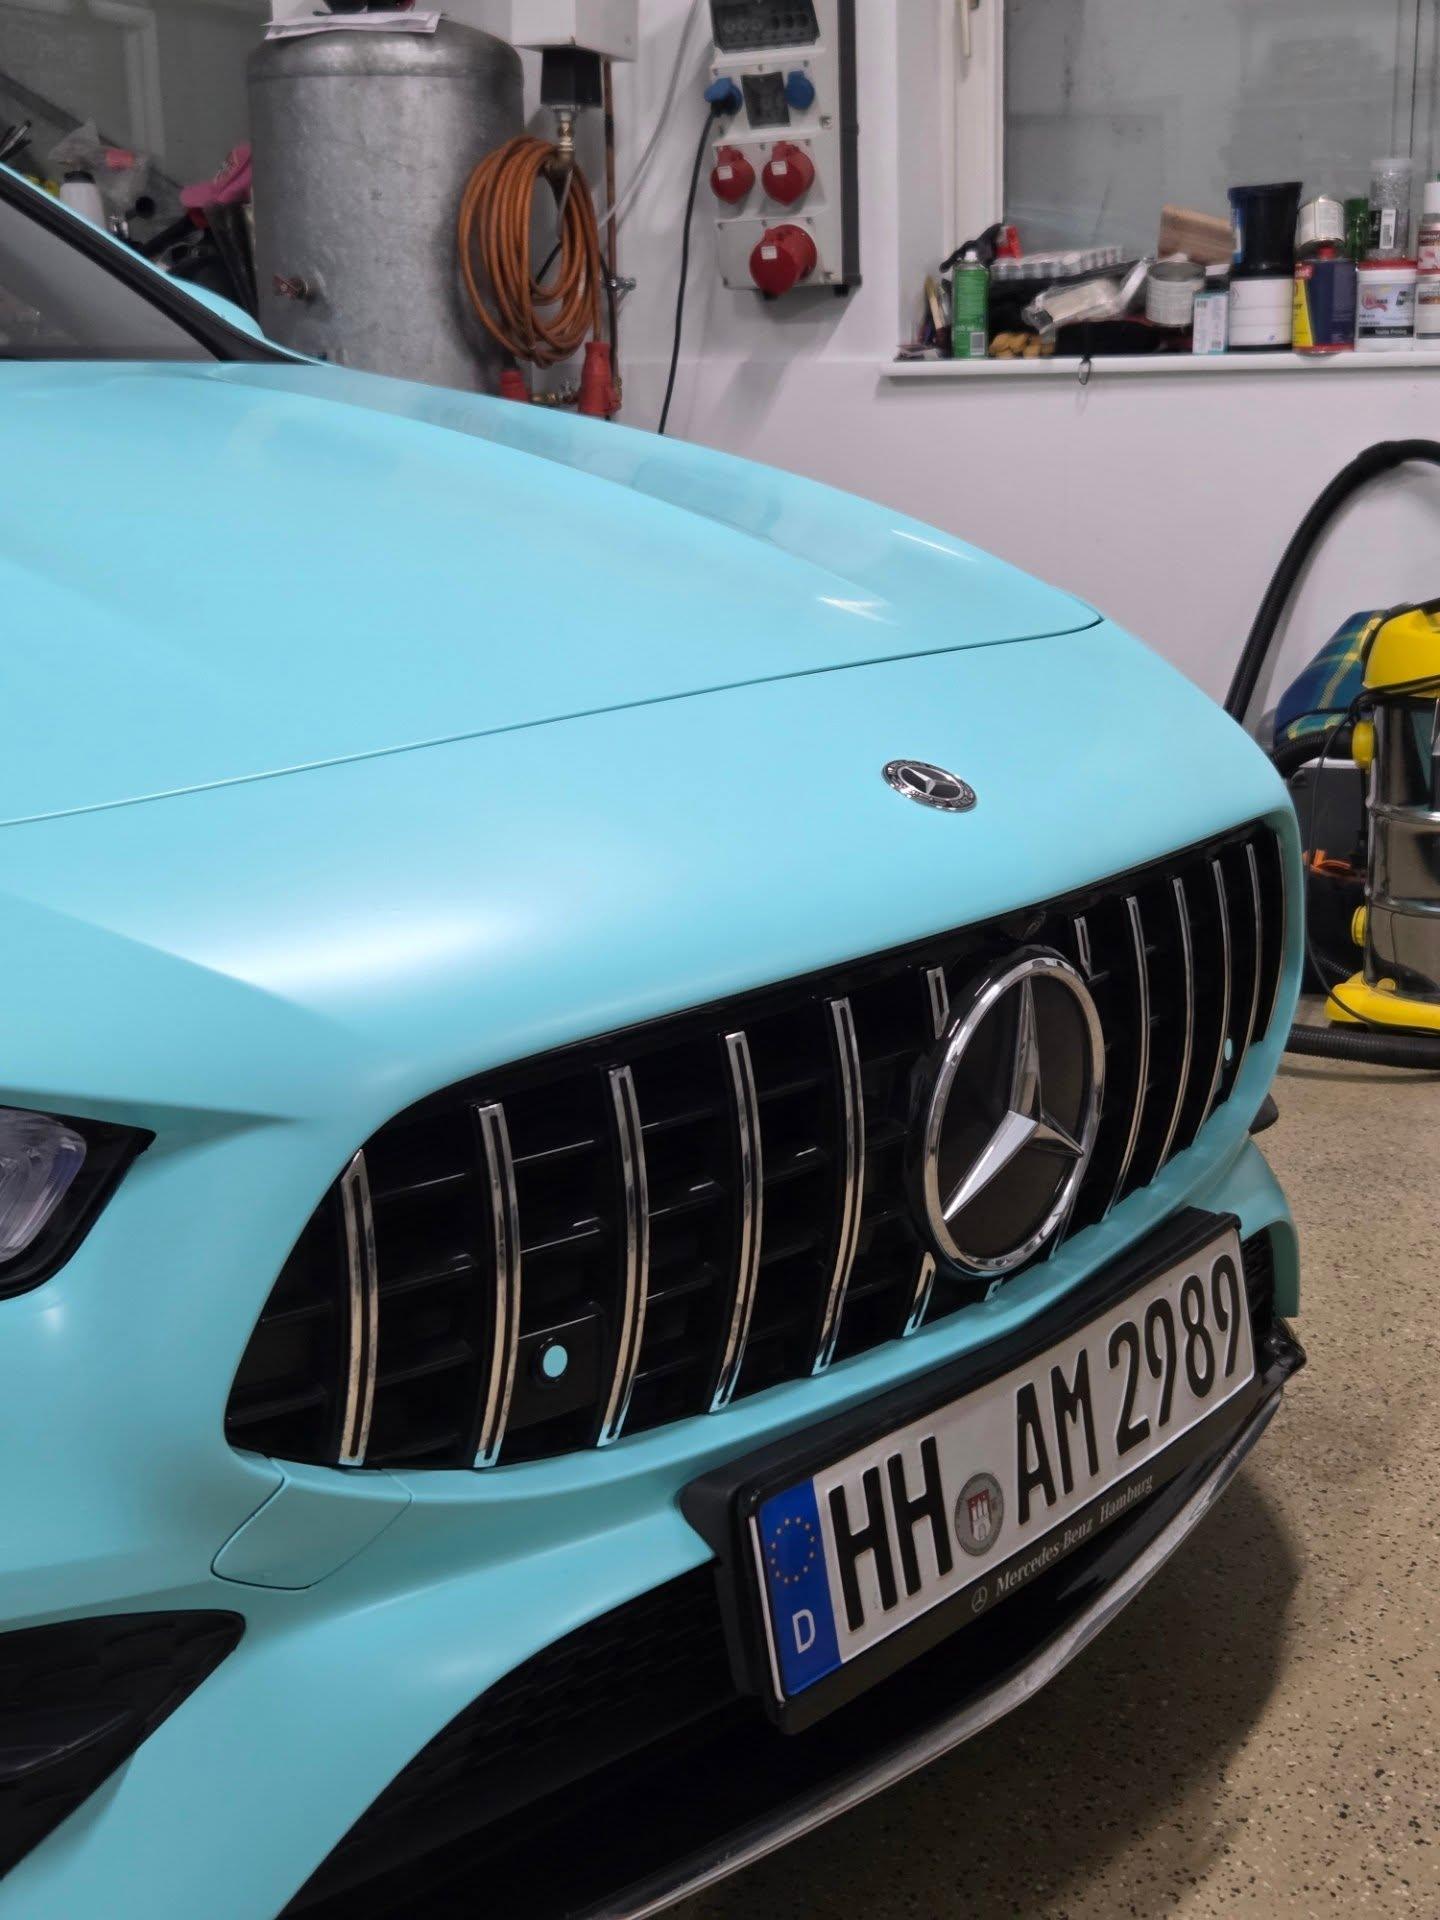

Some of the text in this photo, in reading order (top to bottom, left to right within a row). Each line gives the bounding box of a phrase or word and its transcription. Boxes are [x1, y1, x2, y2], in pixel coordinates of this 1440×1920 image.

[829, 1255, 1239, 1632] HH AM 2989
[996, 1475, 1152, 1596] Mercedes-Benz Hamburg
[792, 1609, 816, 1653] D
